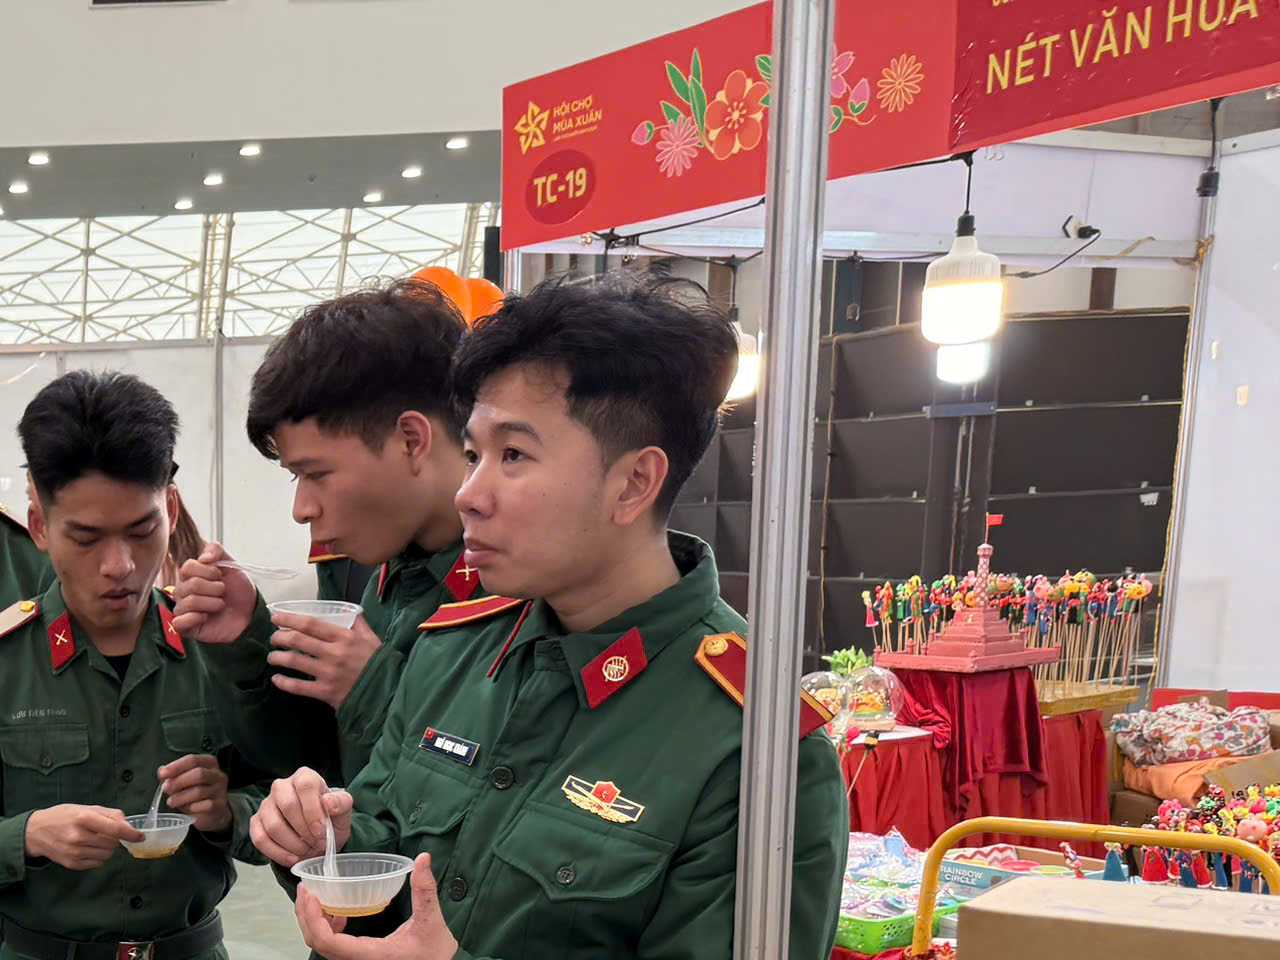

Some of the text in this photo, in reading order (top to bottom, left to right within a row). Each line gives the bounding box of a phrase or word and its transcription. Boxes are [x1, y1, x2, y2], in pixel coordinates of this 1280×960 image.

[987, 32, 1061, 94] NÉT
[1070, 6, 1152, 69] VĂN
[533, 167, 587, 208] TC-19
[940, 866, 984, 879] RAINBOW
[945, 874, 976, 885] CIRCLE
